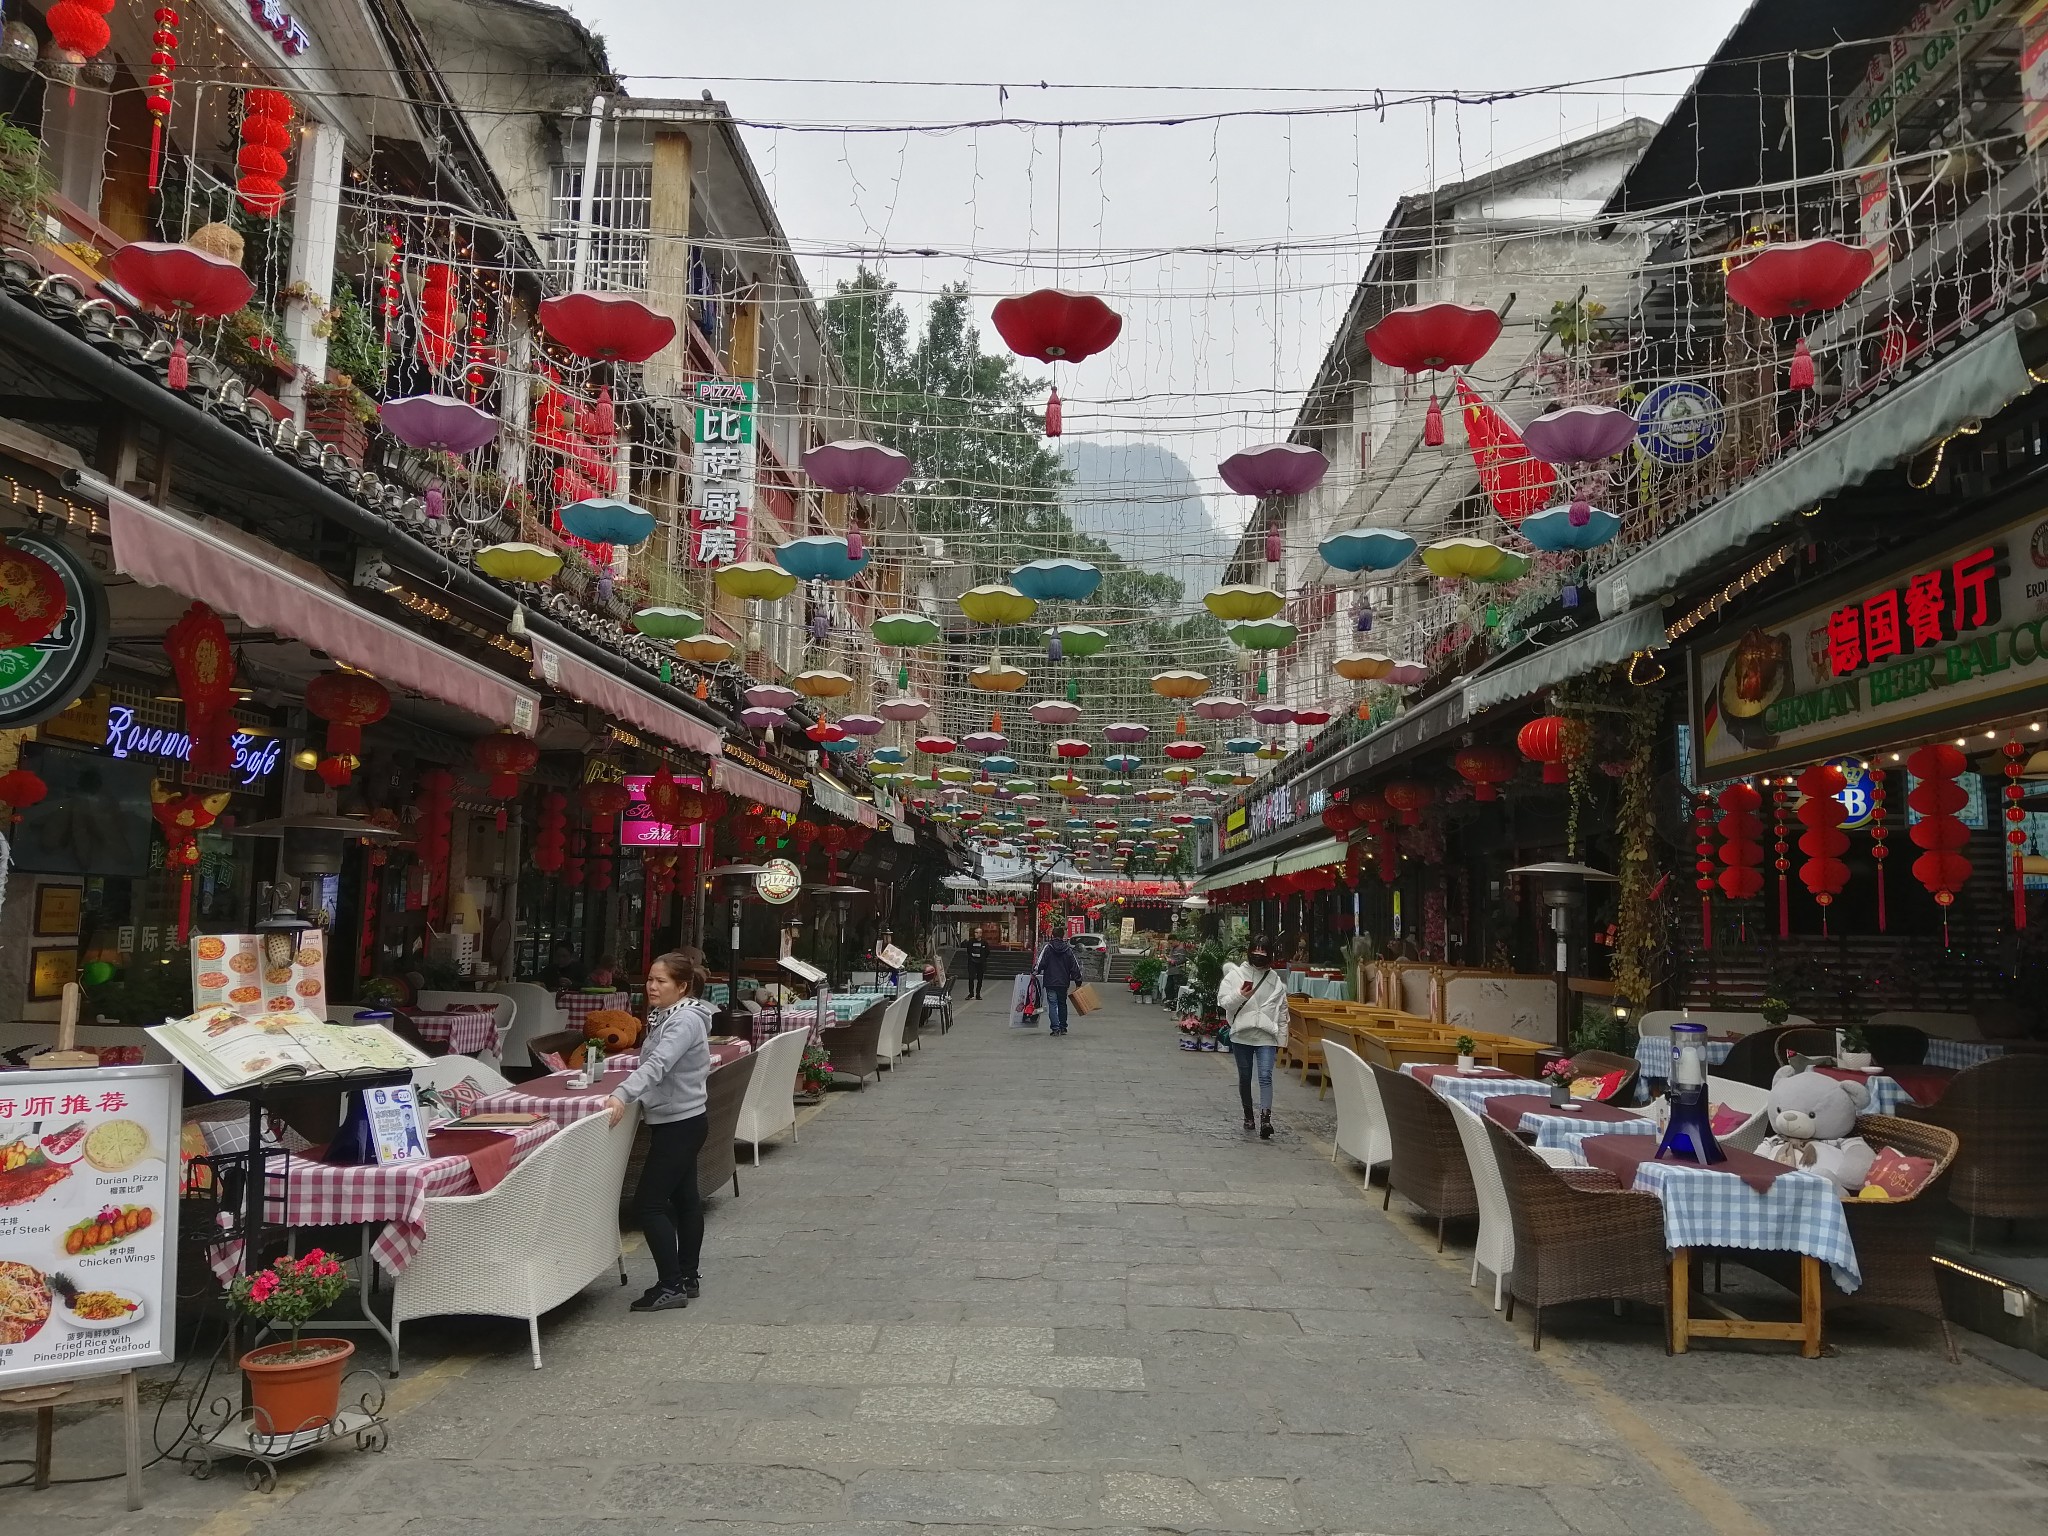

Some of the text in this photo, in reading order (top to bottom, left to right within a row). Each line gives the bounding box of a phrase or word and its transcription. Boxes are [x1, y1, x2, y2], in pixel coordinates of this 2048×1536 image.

[1867, 0, 2003, 129] BEER GARD
[700, 384, 746, 400] PIZZA
[696, 405, 742, 563] 比萨厨房
[1827, 547, 1996, 677] 德国餐厅
[1762, 676, 1862, 736] GERMAN
[1870, 653, 1940, 708] BEER
[230, 733, 281, 784] Café
[760, 872, 798, 887] PIZZA
[95, 1174, 159, 1186] Durian Pizza
[110, 1184, 144, 1195] 榴莲比萨
[19, 1224, 51, 1235] Steak
[79, 1254, 156, 1268] Chicken Wings
[33, 1340, 151, 1362] Pineapple and Seafood
[55, 1334, 131, 1351] Fried Rice with
